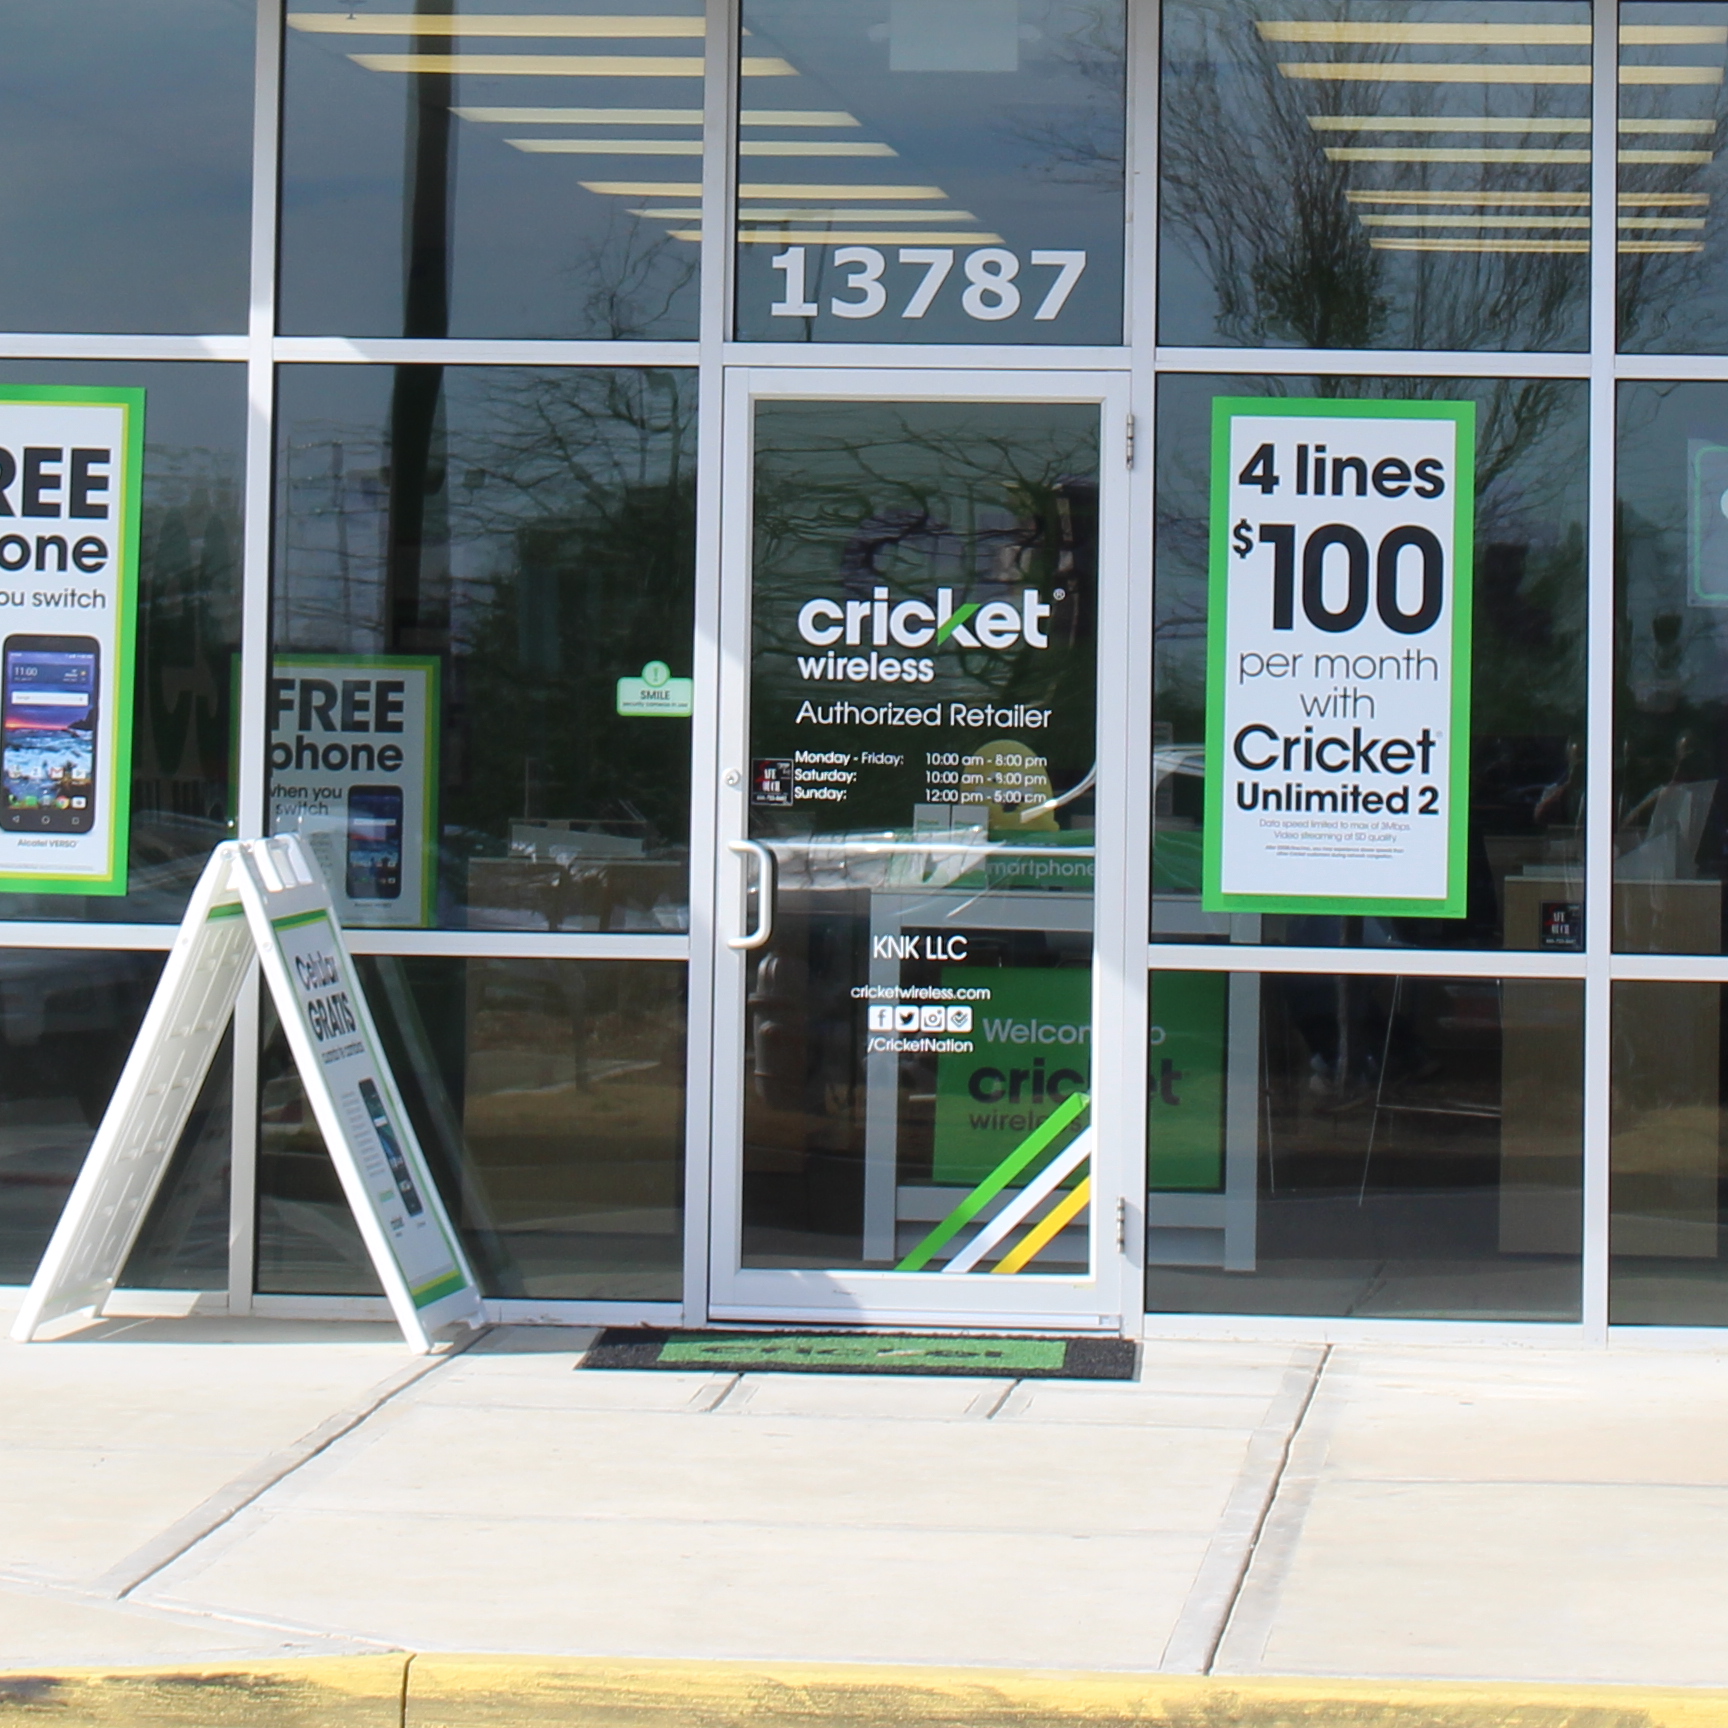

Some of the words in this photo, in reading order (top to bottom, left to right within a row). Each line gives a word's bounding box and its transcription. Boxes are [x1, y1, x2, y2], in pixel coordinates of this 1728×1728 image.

[770, 246, 1087, 320] 13787
[1238, 443, 1280, 495] 4
[1296, 443, 1445, 499] lines
[1232, 518, 1444, 635] $100
[32, 588, 107, 609] switch
[797, 585, 1051, 649] cricket
[796, 651, 935, 683] wireless
[1239, 651, 1303, 685] per
[1315, 649, 1438, 681] month
[271, 678, 405, 733] FREE
[640, 690, 671, 700] SMILE
[1299, 686, 1375, 719] with
[795, 700, 943, 727] Authorized
[949, 702, 1053, 728] Retailer
[271, 735, 404, 777] phone
[794, 750, 852, 766] Monday
[860, 751, 905, 767] Friday:
[925, 752, 960, 766] 10:00
[961, 755, 985, 766] am
[995, 753, 1022, 767] 8:00
[1024, 755, 1048, 769] pm
[1233, 723, 1436, 775] Cricket
[794, 768, 858, 784] Saturday:
[925, 770, 959, 784] 10:00
[961, 773, 985, 784] am
[1024, 774, 1047, 787] pm
[313, 787, 343, 802] you
[794, 786, 848, 802] Sunday:
[925, 788, 959, 802] 12:00
[960, 791, 984, 804] pm
[993, 789, 1022, 803] 5:00
[1236, 781, 1410, 815] Unlimited
[1418, 786, 1440, 815] 2
[275, 802, 329, 816] switch
[1259, 818, 1281, 828] Data
[1282, 820, 1309, 830] speed
[1273, 830, 1299, 839] Video
[1300, 831, 1343, 841] streaming
[17, 839, 48, 848] Alcatel
[873, 935, 920, 960] KNK
[925, 935, 968, 961] LLC
[850, 984, 992, 1000] cricketwireless.com
[307, 991, 357, 1043] GRATIS
[982, 1018, 1092, 1044] Welco
[867, 1037, 974, 1053] /CricketNation
[968, 1057, 1182, 1106] crict
